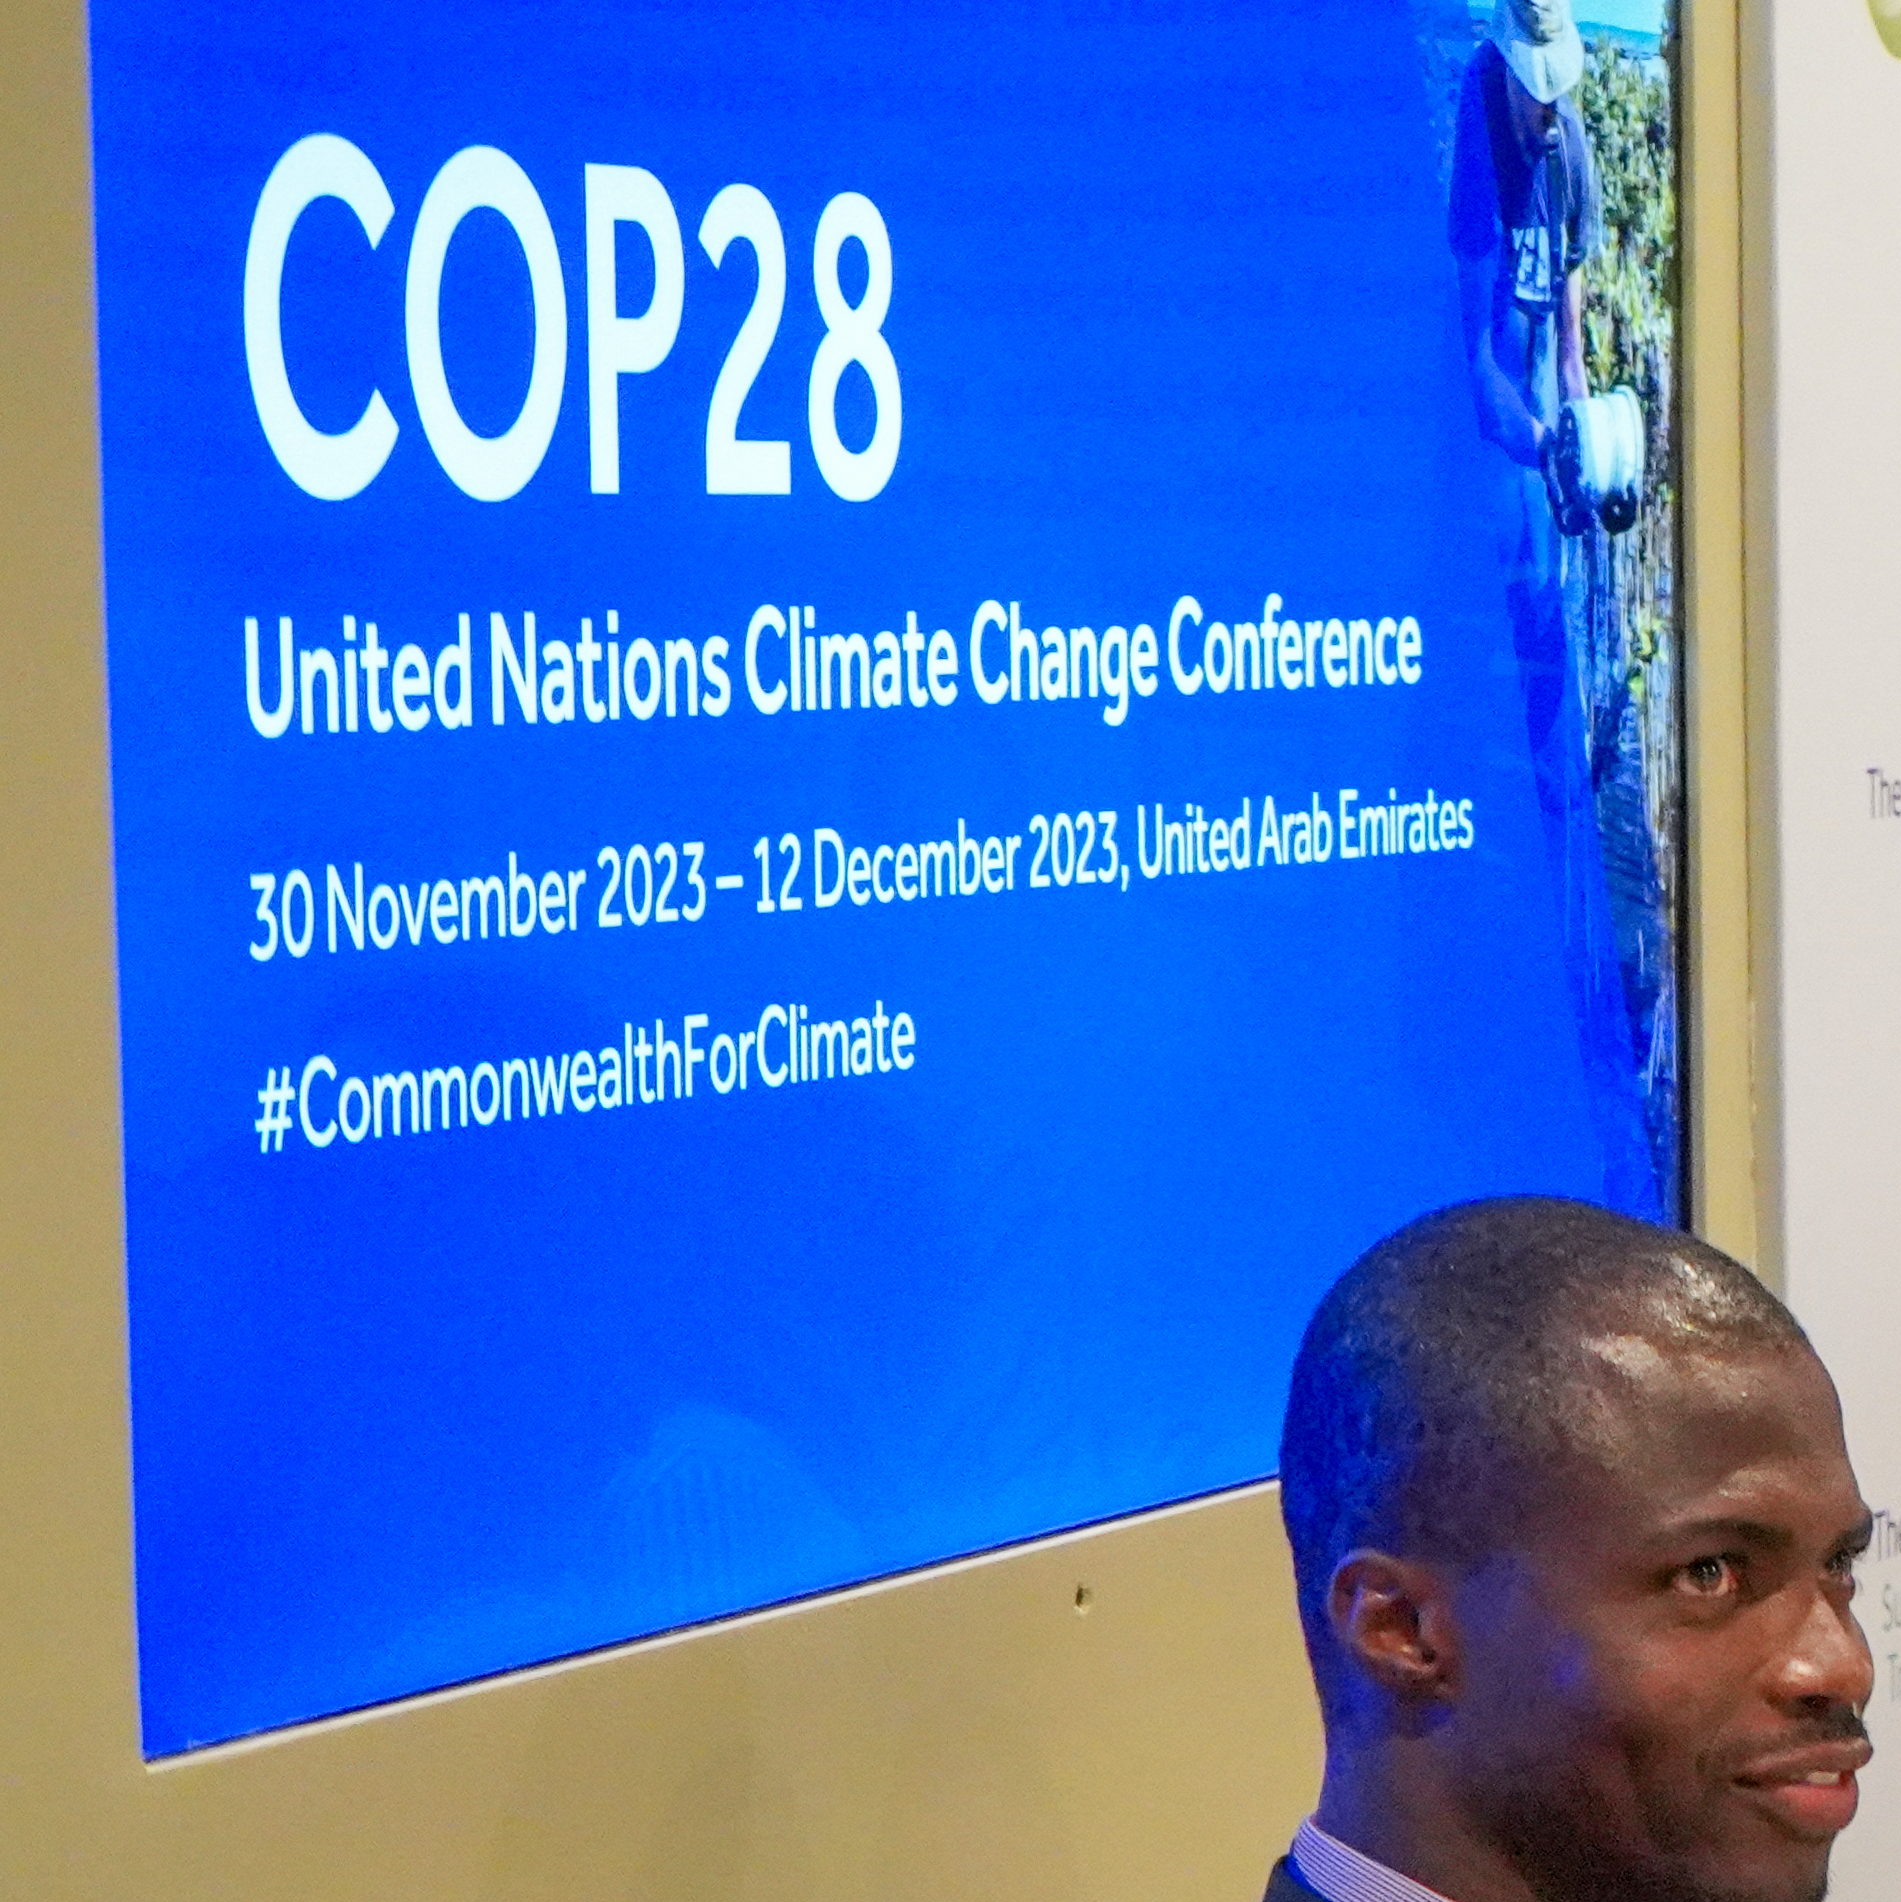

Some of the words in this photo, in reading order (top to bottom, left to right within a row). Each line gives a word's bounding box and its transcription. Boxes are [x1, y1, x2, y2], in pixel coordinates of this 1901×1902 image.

[242, 132, 904, 504] COP28
[243, 611, 474, 740] United
[488, 608, 733, 727] Nations
[743, 602, 960, 716] Climate
[968, 598, 1160, 728] Change
[1166, 591, 1424, 697] Conference
[248, 867, 316, 963] 30
[325, 850, 588, 954] November
[595, 840, 708, 929] 2023
[752, 831, 804, 915] 12
[812, 817, 1024, 909] December
[1027, 809, 1131, 892] 2023,
[1136, 796, 1253, 880] United
[1255, 791, 1335, 868] Arab
[1337, 787, 1476, 861] Emirates
[253, 998, 918, 1154] #CommonwealthForClimate
